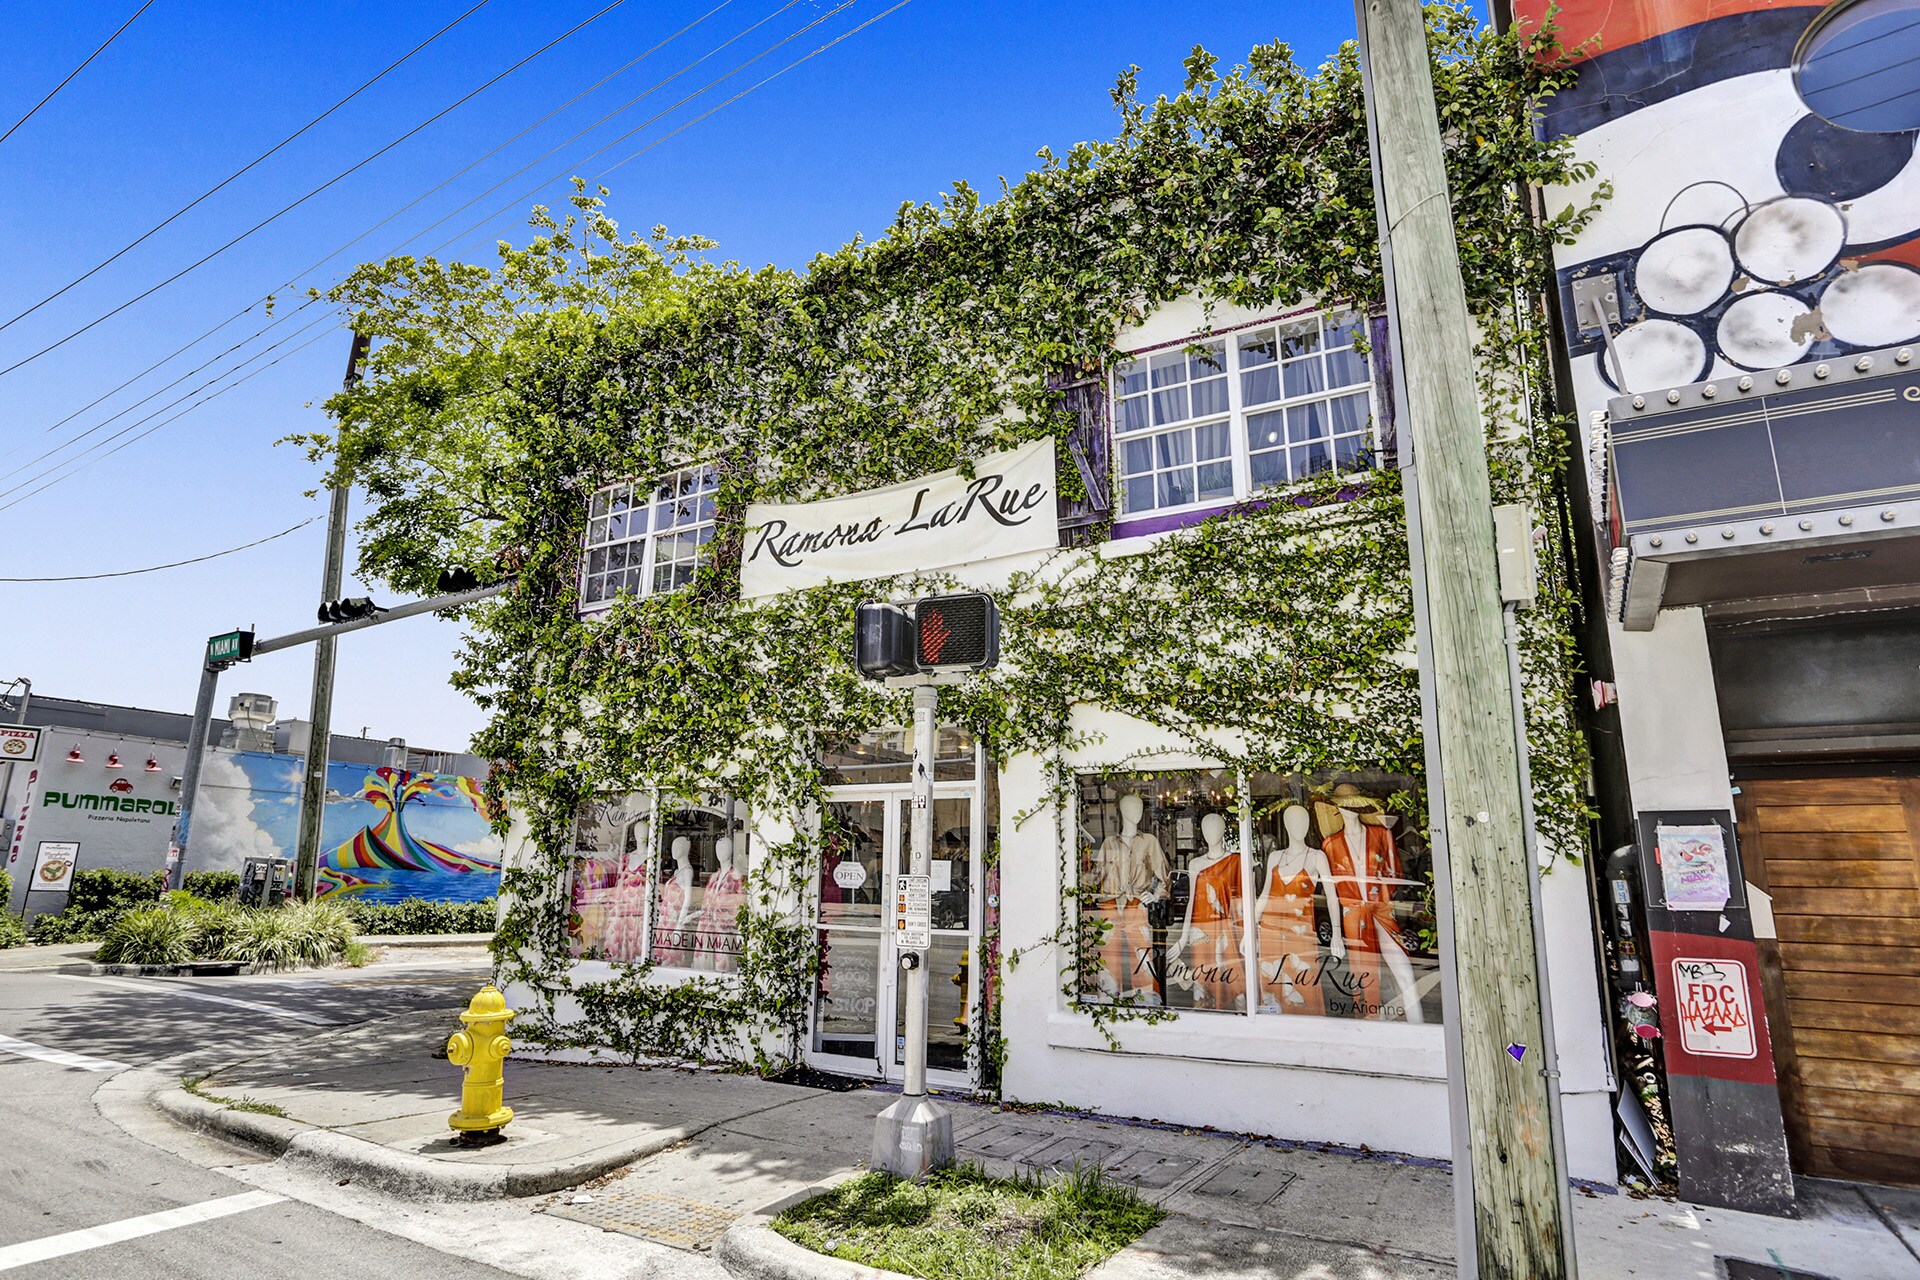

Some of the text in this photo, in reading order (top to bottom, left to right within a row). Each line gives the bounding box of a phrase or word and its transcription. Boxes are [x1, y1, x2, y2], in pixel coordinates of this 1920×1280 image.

[748, 474, 1048, 567] Ramona LaRue
[214, 638, 231, 656] MIAMI
[231, 637, 239, 652] AV
[0, 729, 35, 739] PIZZA
[88, 814, 151, 824] Pizzeria Napoletana
[835, 871, 864, 881] OPEN
[652, 932, 743, 951] MADE IN MIAM
[1132, 946, 1375, 997] Ramona LaRue
[1688, 983, 1735, 1004] FDC
[832, 996, 876, 1014] SHOP
[1330, 999, 1405, 1017] by Arianne
